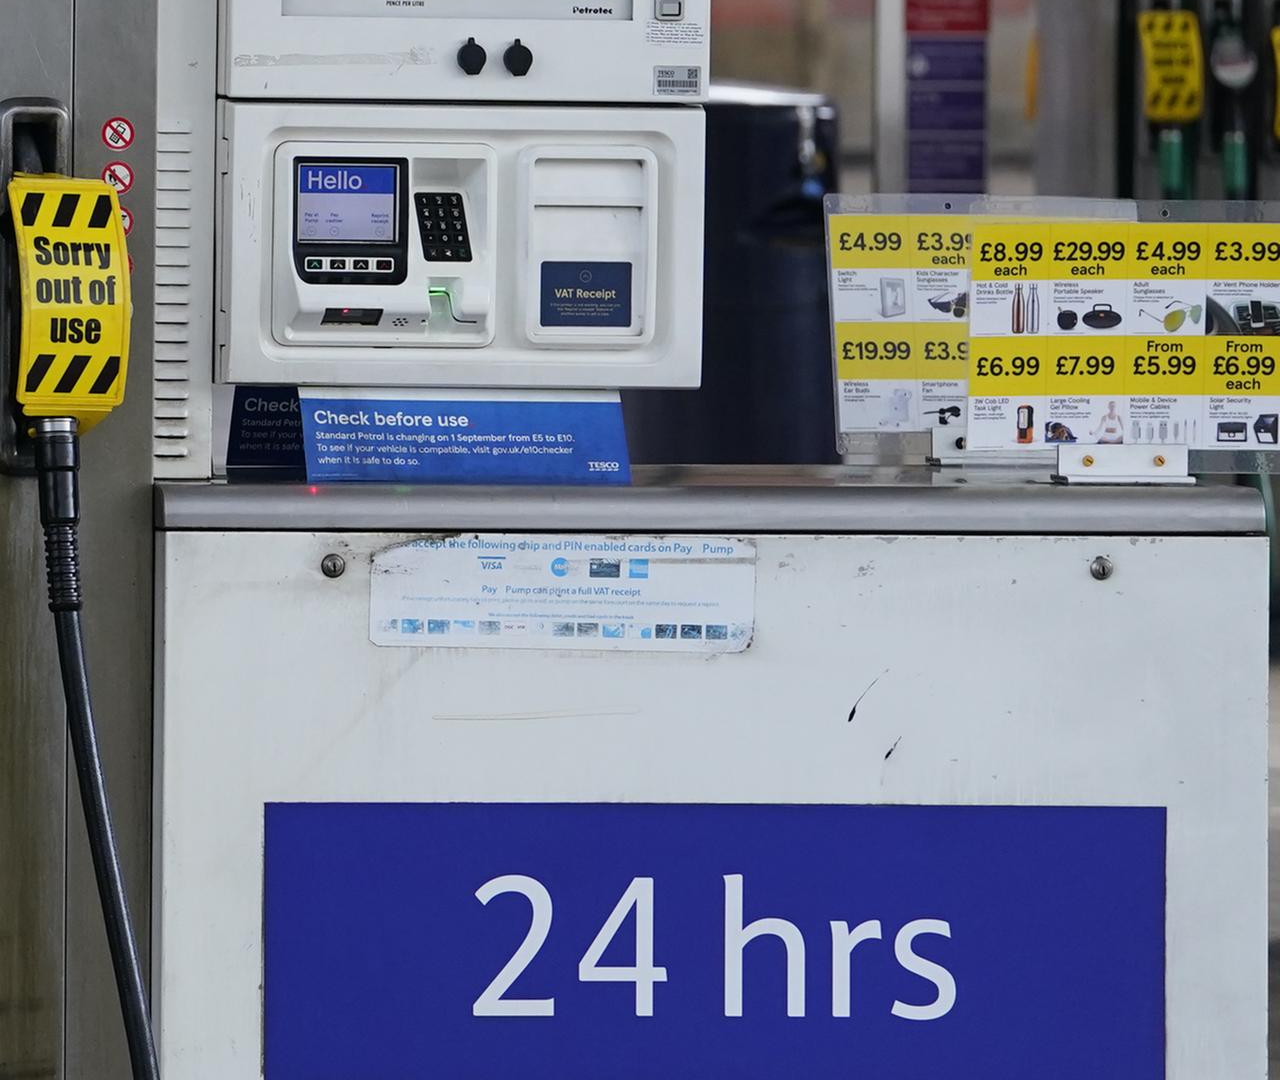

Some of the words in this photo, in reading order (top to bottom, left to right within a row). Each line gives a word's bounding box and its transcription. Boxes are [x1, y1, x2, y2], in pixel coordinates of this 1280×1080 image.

[308, 170, 361, 191] Hello
[839, 232, 902, 251] £4.99
[1053, 241, 1125, 261] £29.99
[1136, 241, 1201, 261] £4.99
[34, 236, 110, 269] Sorry
[932, 253, 965, 265] each
[980, 242, 1043, 262] £8.99
[1215, 241, 1280, 262] £3.99
[994, 264, 1027, 276] each
[1071, 263, 1105, 275] each
[1151, 263, 1185, 275] each
[36, 276, 81, 304] out
[88, 277, 116, 305] of
[555, 288, 574, 298] VAT
[576, 288, 616, 301] Receipt
[50, 317, 102, 344] use
[842, 341, 911, 360] £19.99
[1147, 340, 1183, 352] From
[1226, 340, 1263, 353] From
[977, 356, 1040, 376] £6.99
[1056, 356, 1115, 375] £7.99
[1133, 356, 1196, 375] £5.99
[1213, 356, 1275, 376] £6.99
[1226, 378, 1261, 390] each
[314, 410, 370, 425] Check
[374, 411, 433, 427] before
[437, 416, 469, 427] use
[588, 461, 619, 470] TESCO
[473, 875, 668, 1016] 24
[723, 874, 956, 1020] hrs
